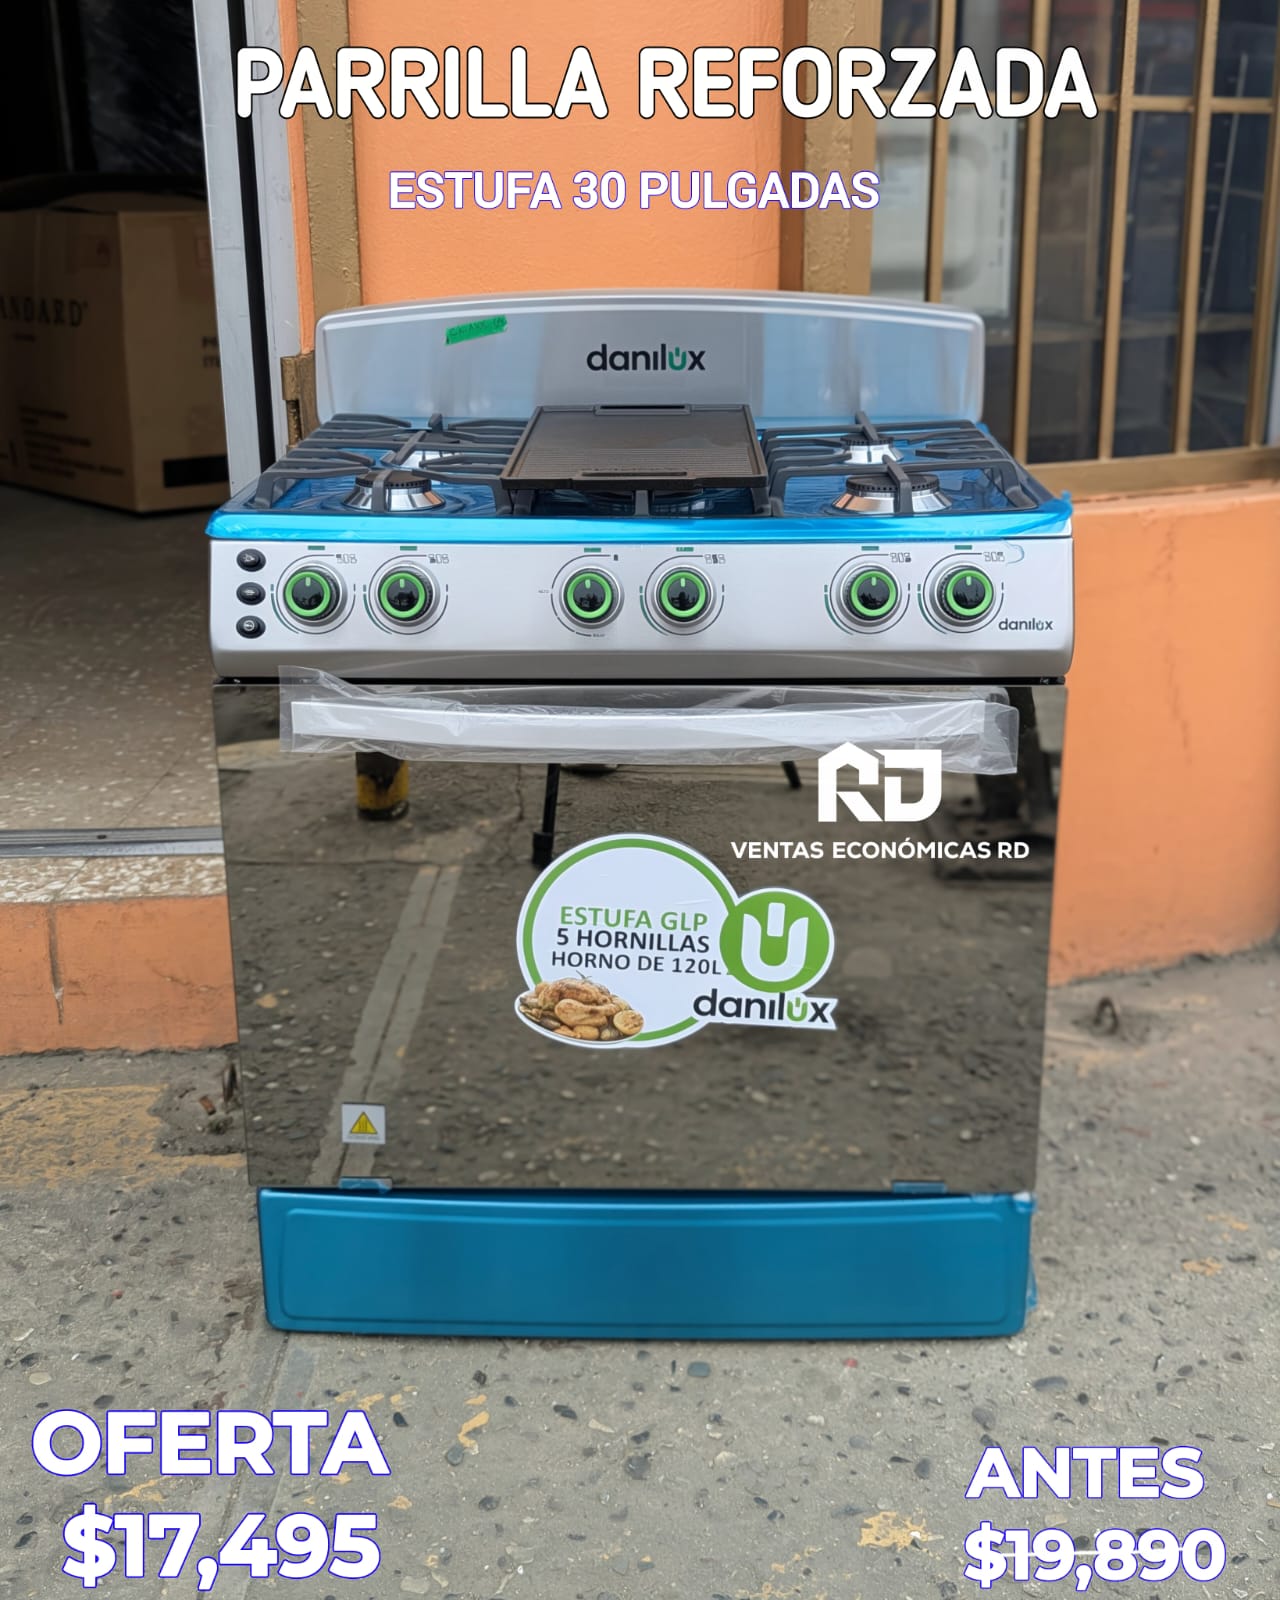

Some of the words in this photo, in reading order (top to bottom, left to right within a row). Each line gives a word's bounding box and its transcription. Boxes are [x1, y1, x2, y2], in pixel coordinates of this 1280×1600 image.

[586, 343, 706, 372] danilux
[998, 617, 1054, 631] danilux
[560, 905, 653, 929] ESTUFA
[660, 911, 709, 932] GLP
[556, 927, 570, 946] 5
[576, 928, 711, 954] HORNILLAS
[551, 950, 631, 971] HORNO
[637, 955, 665, 972] DE
[672, 957, 722, 976] 120L
[692, 988, 830, 1024] danilux
